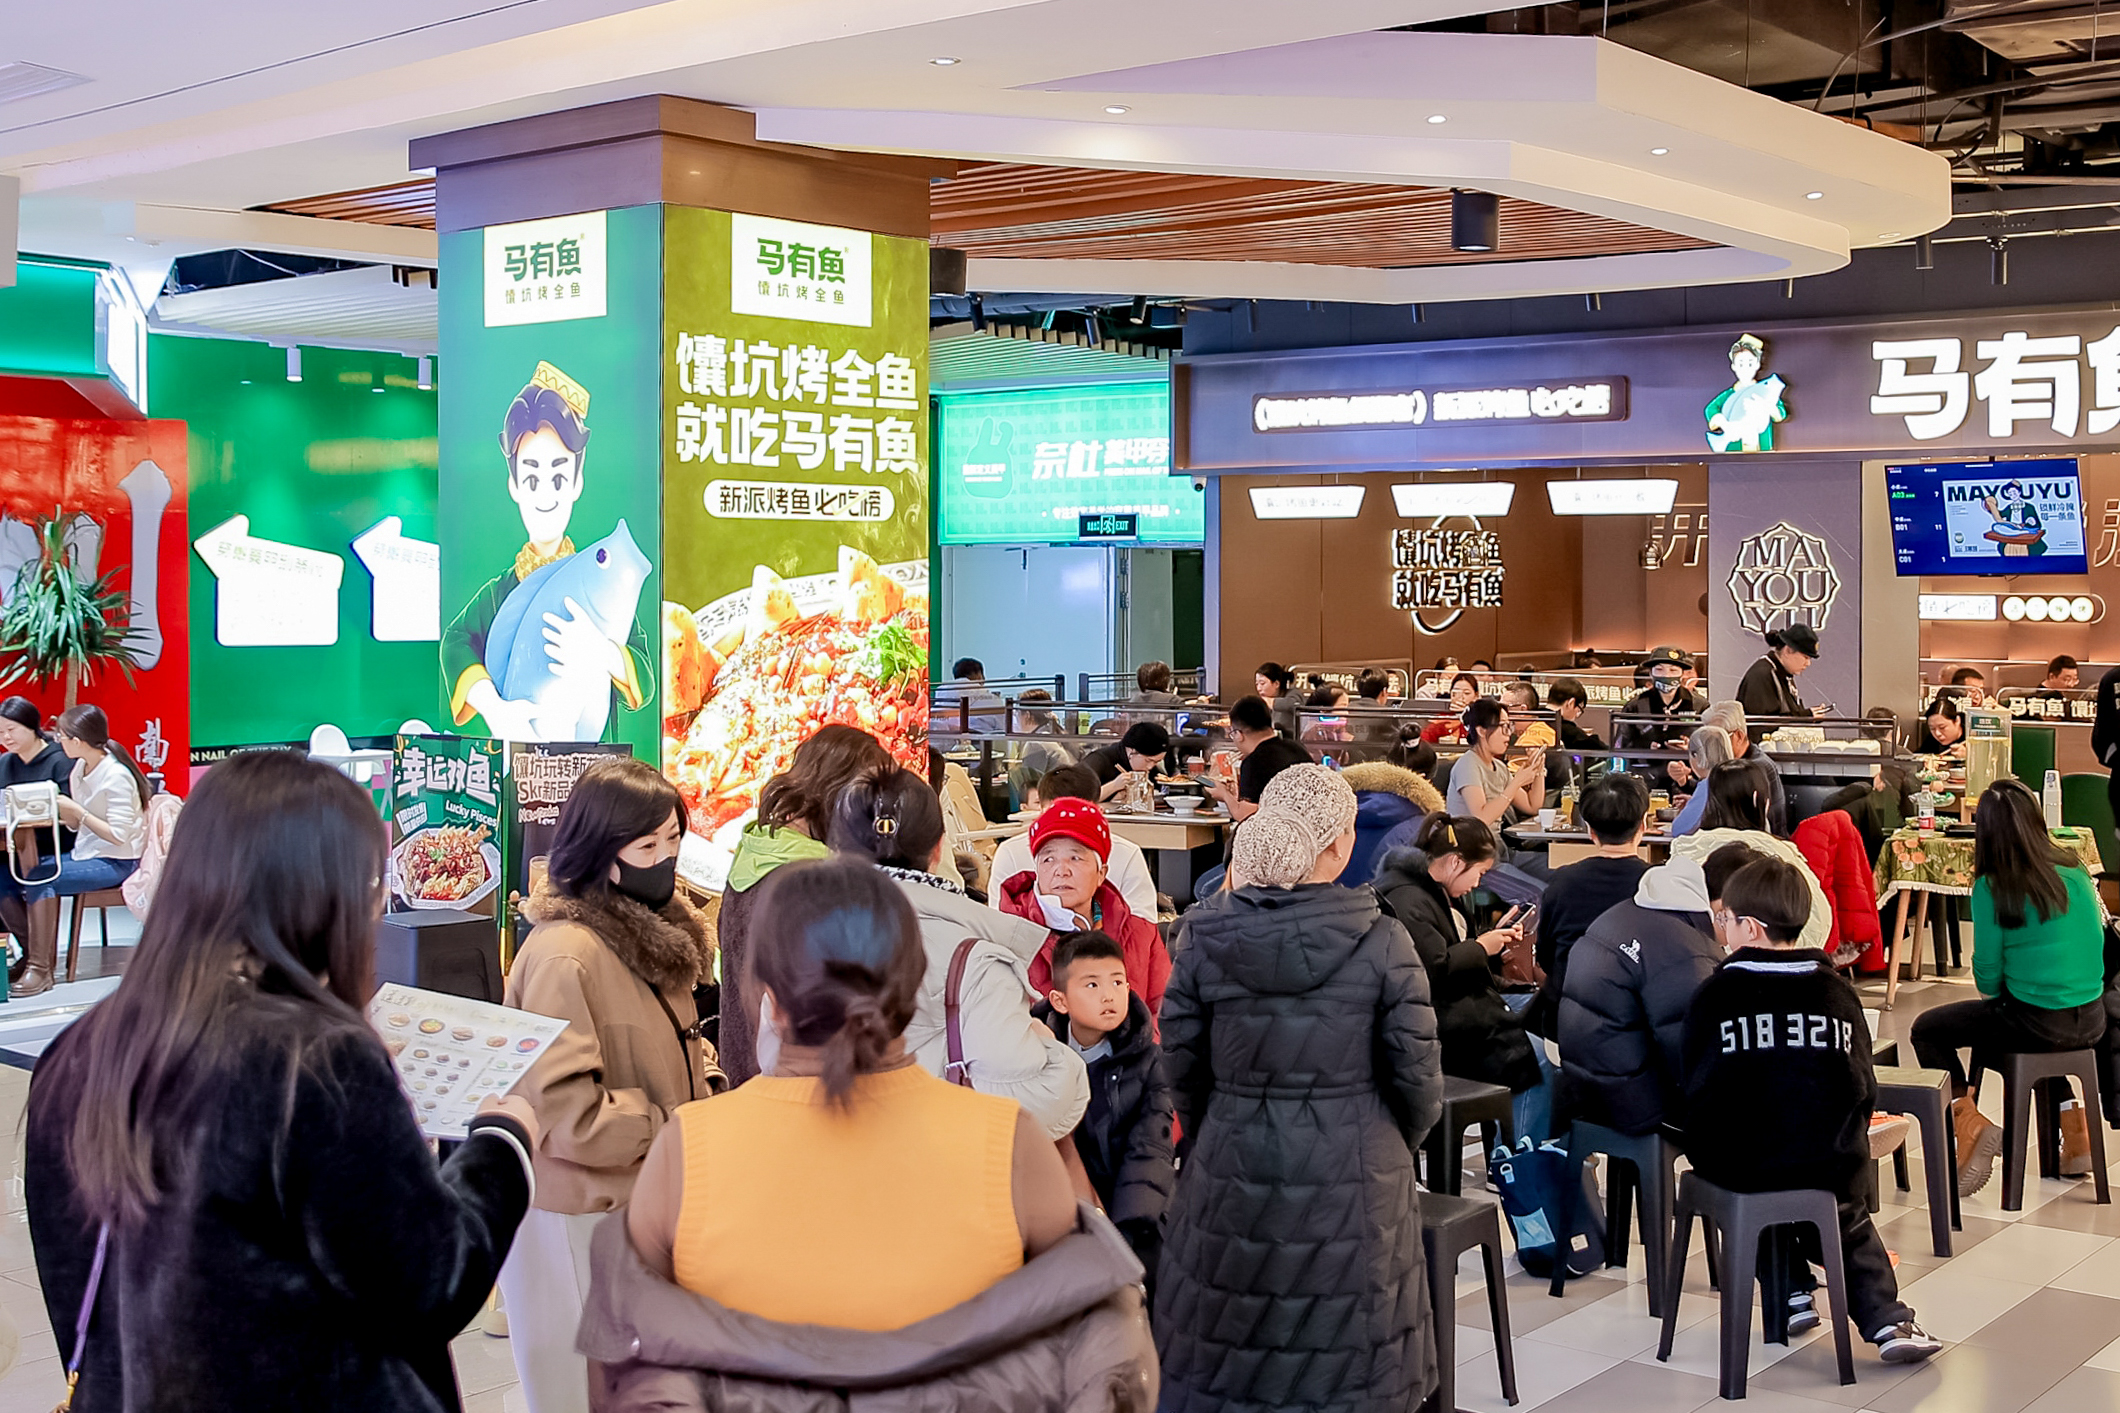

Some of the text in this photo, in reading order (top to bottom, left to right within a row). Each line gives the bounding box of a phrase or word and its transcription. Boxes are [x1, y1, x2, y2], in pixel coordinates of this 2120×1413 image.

[676, 332, 919, 411] 馕坑烤全鱼
[676, 401, 920, 474] 就吃马有鱼
[719, 484, 881, 517] 新派烤鱼必吃榜
[1115, 521, 1129, 531] EXIT
[1750, 536, 1822, 573] MA
[1735, 569, 1832, 606] YOU
[397, 747, 497, 807] 幸运双鱼
[445, 800, 470, 819] Lucky
[470, 809, 497, 827] Pisces
[1720, 1013, 1852, 1053] 518 3218
